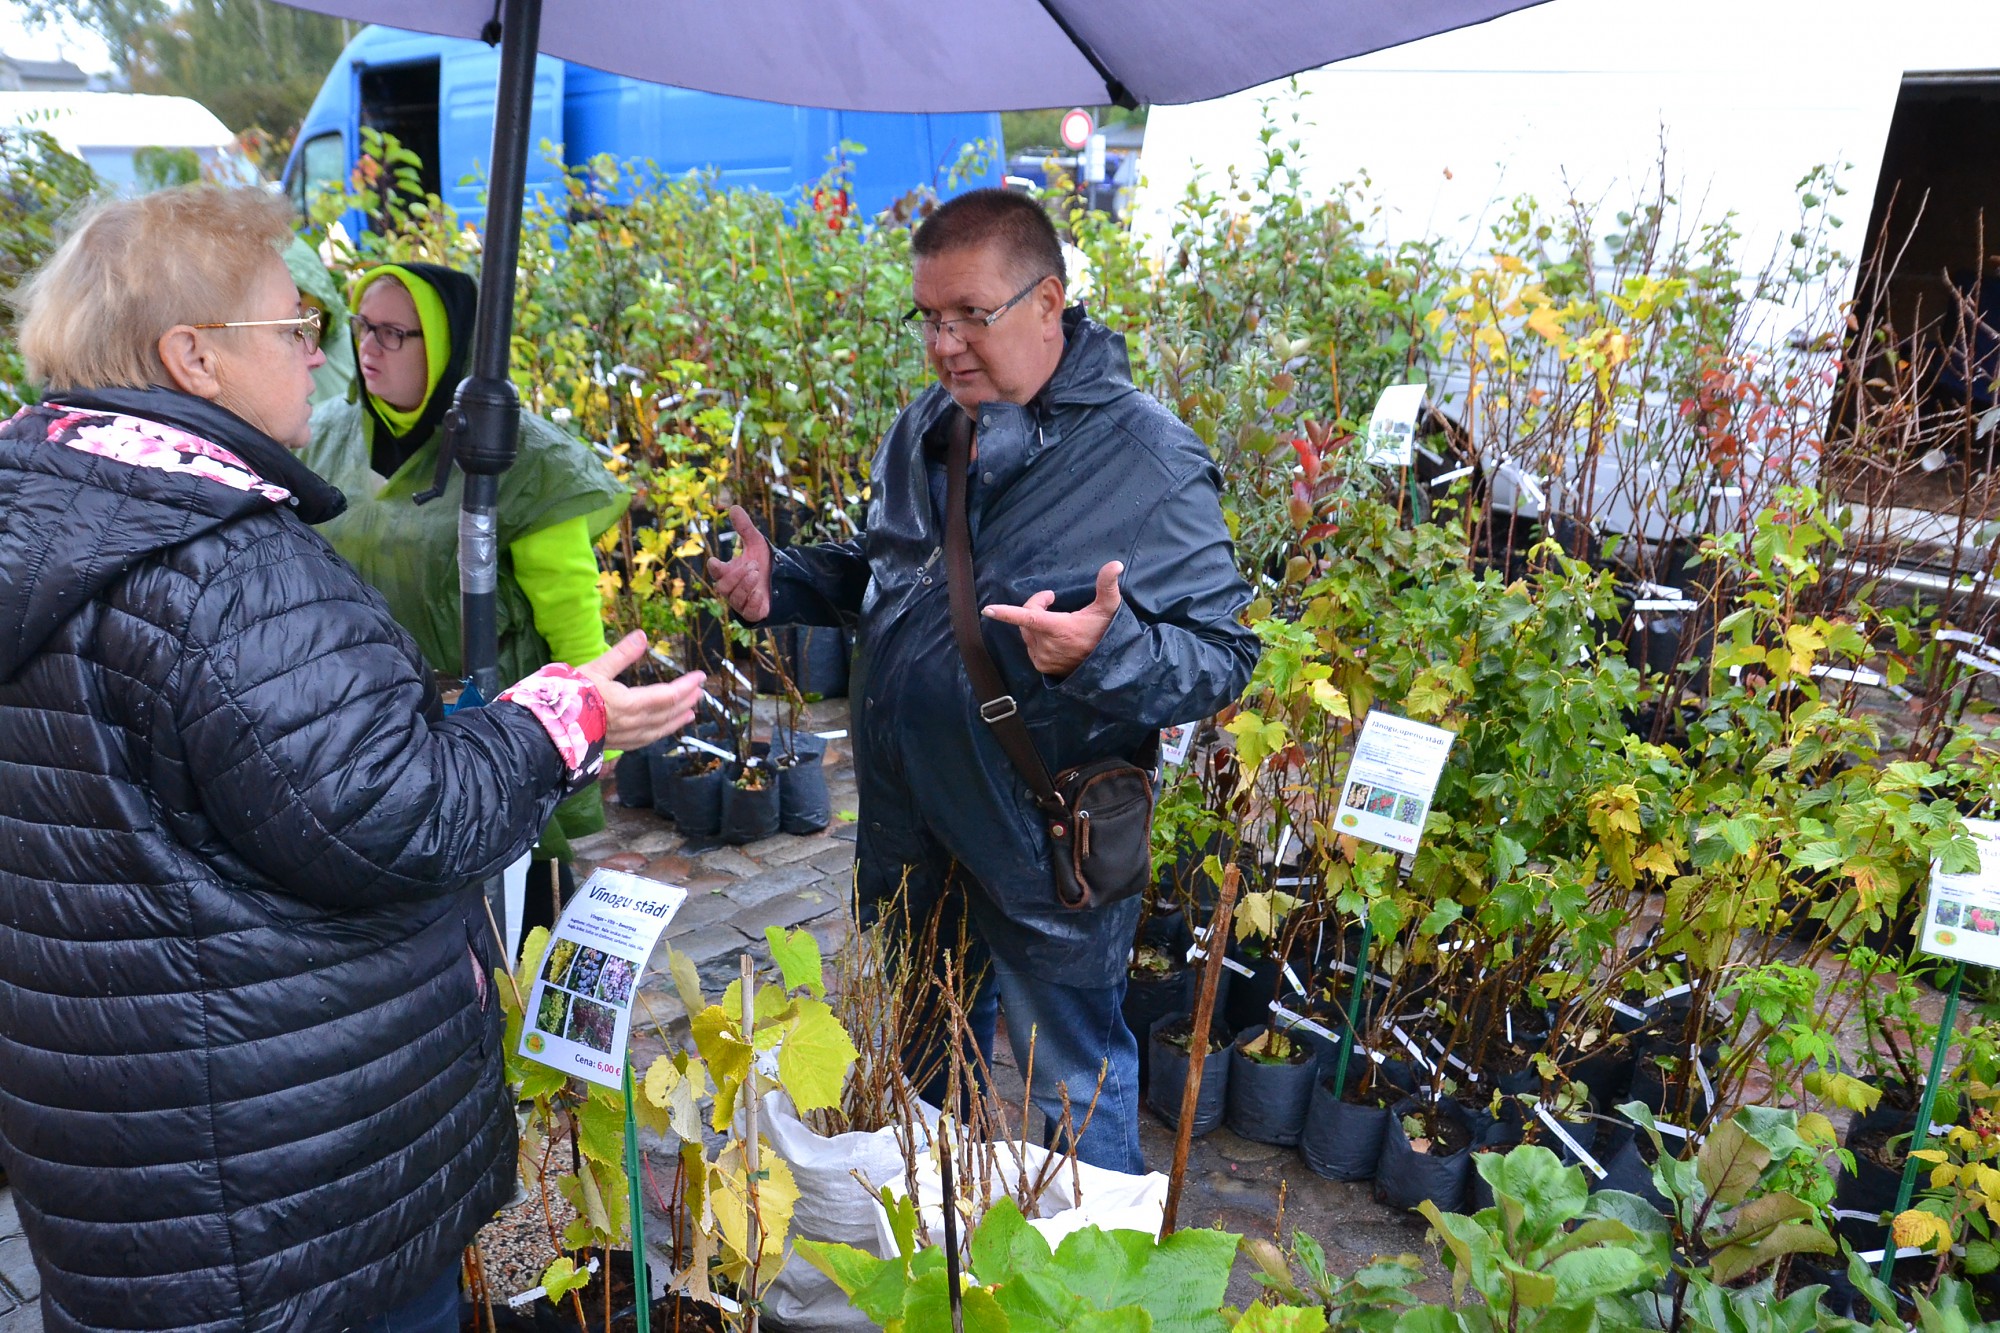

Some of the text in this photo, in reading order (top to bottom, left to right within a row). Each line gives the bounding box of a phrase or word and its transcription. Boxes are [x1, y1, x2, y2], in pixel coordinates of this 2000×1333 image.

[589, 885, 670, 919] Vīnogu stādi
[574, 1053, 621, 1077] Cena: 6,00 €
